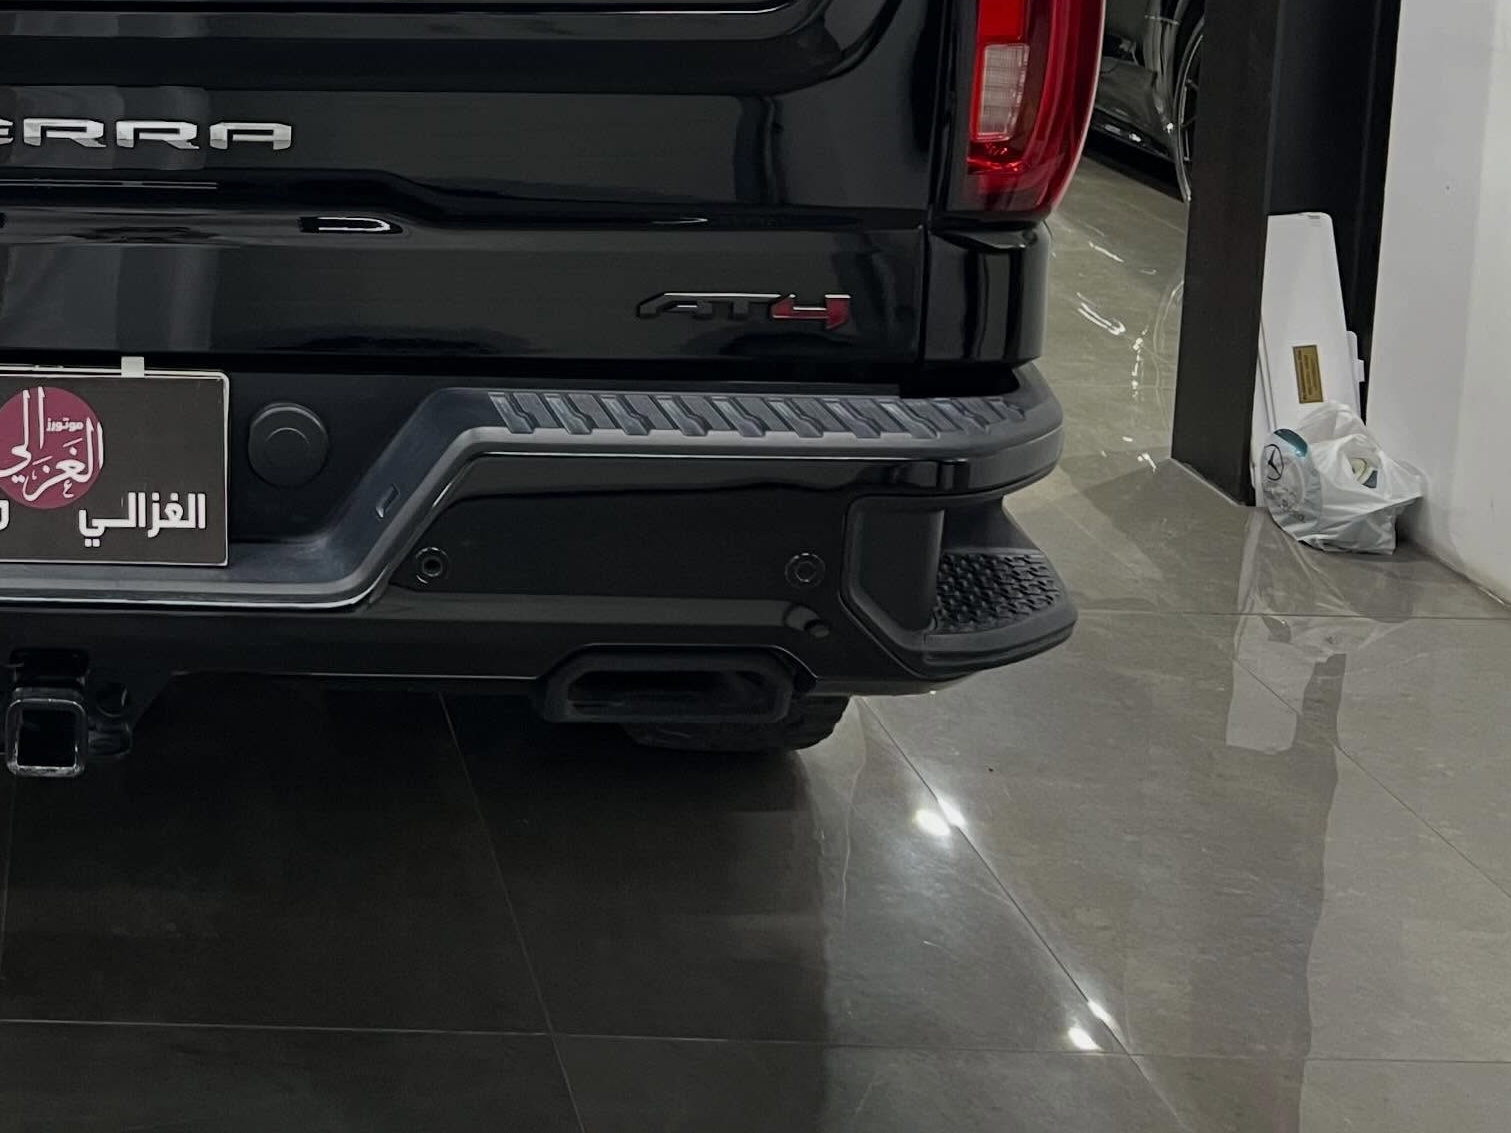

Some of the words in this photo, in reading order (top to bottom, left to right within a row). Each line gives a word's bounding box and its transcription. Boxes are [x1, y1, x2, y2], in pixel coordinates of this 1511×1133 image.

[638, 292, 851, 331] AT4
[46, 418, 83, 431] موتورز
[79, 492, 205, 547] الغزالي
